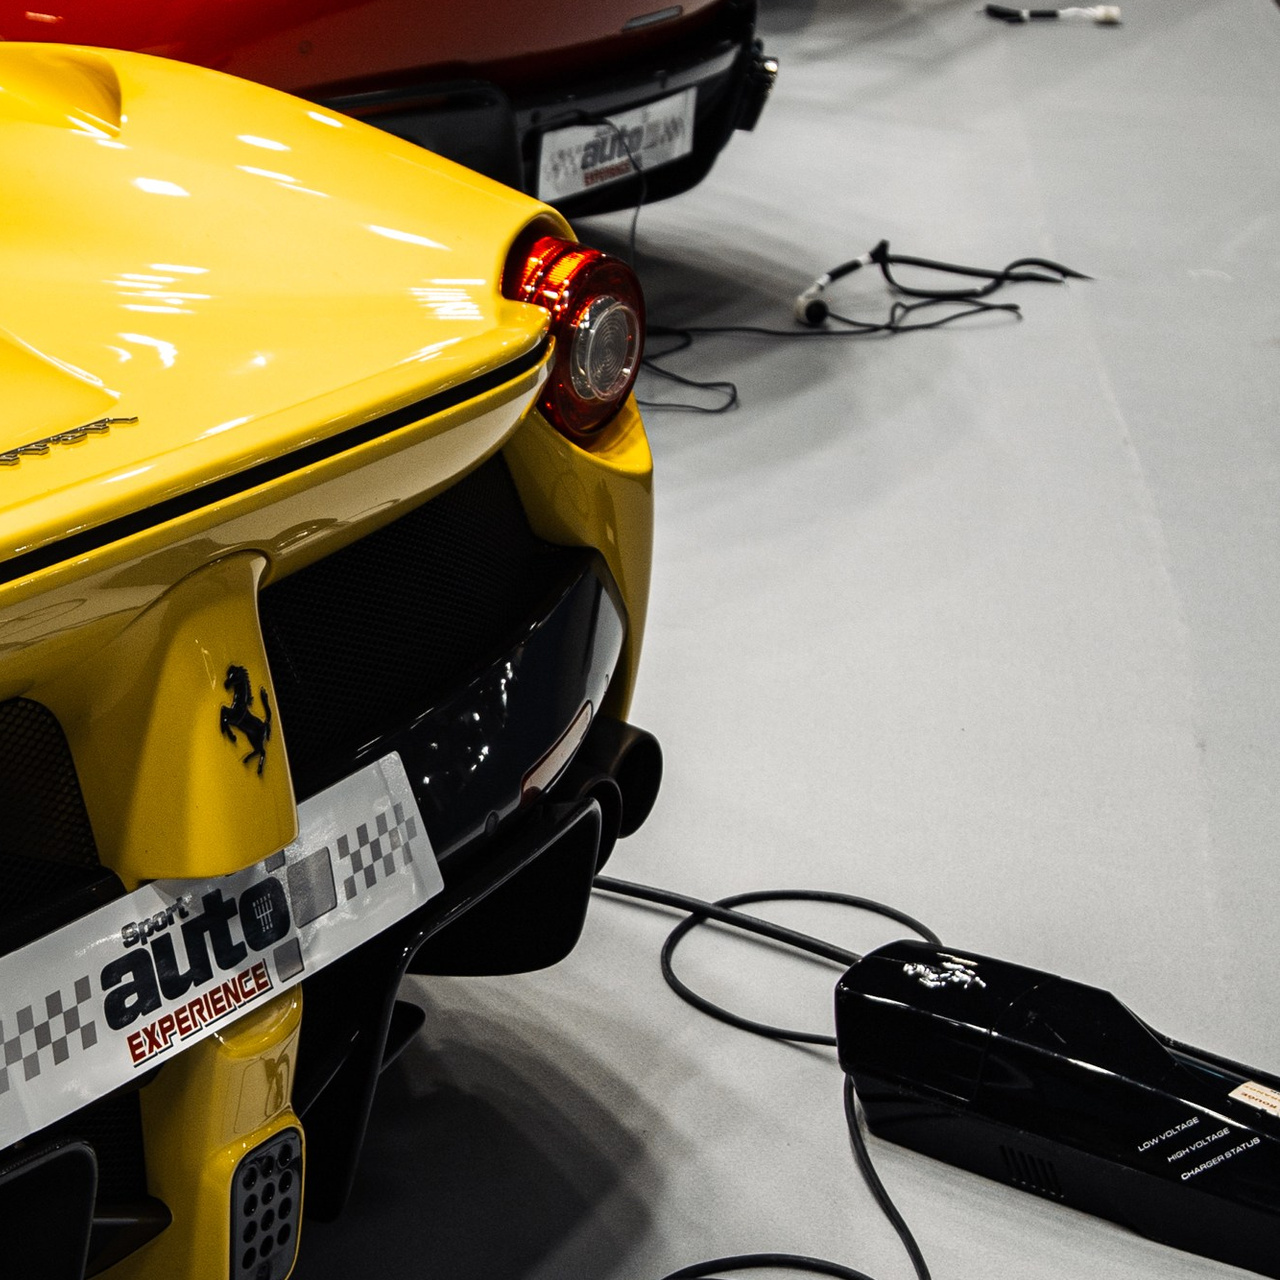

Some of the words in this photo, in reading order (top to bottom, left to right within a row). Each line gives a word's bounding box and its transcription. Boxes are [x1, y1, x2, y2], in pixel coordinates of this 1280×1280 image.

[121, 896, 190, 949] Sport
[100, 877, 292, 1031] auto
[126, 959, 274, 1068] EXPERIENCE
[1137, 1136, 1159, 1152] LOW
[1159, 1116, 1200, 1141] VOLTAGE
[1167, 1147, 1190, 1163] HIGH
[1189, 1127, 1231, 1151] VOLTAGE
[1180, 1153, 1225, 1180] CHARGER
[1224, 1136, 1261, 1159] STATUS
